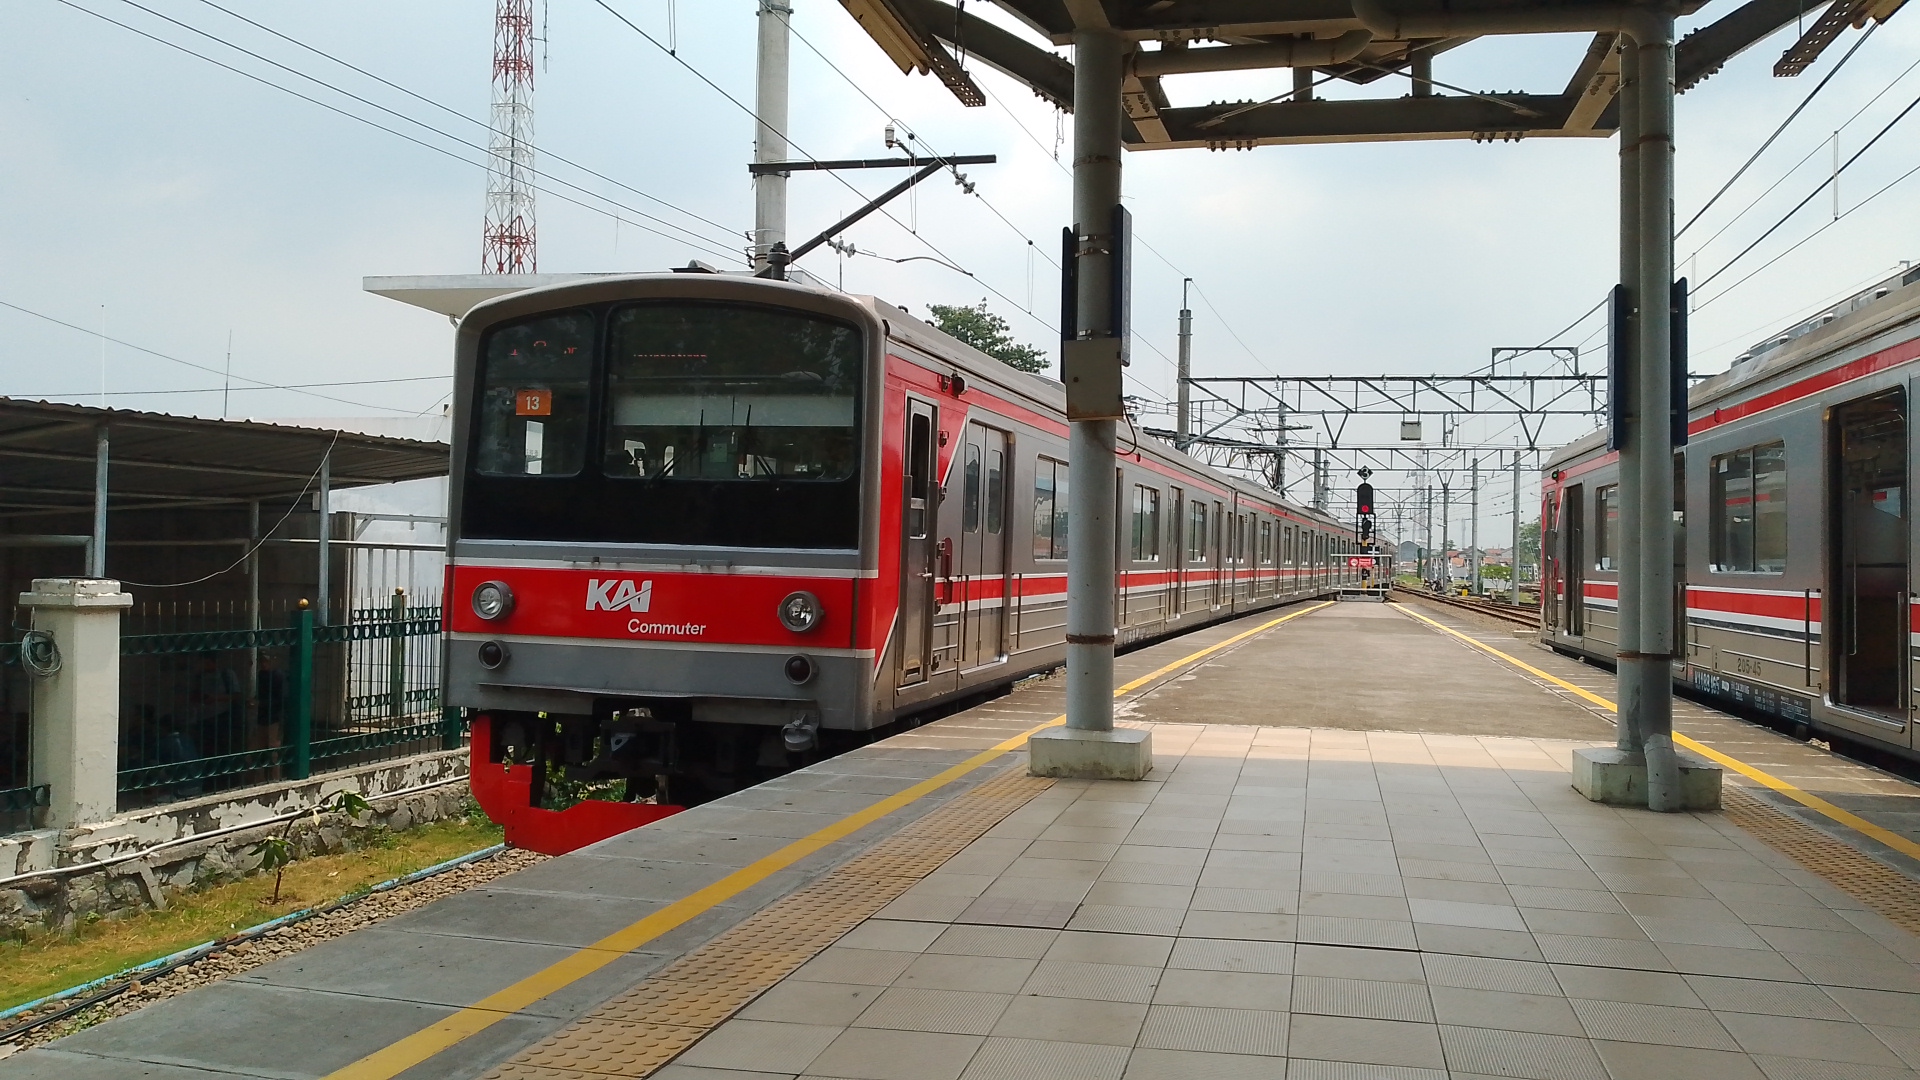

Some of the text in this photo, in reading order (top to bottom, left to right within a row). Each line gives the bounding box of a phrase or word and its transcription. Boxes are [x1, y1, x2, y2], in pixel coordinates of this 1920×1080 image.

[526, 396, 540, 410] 13
[1361, 468, 1369, 479] 3
[586, 579, 653, 612] KAI
[627, 618, 707, 635] Commuter
[1737, 658, 1762, 676] 205-45
